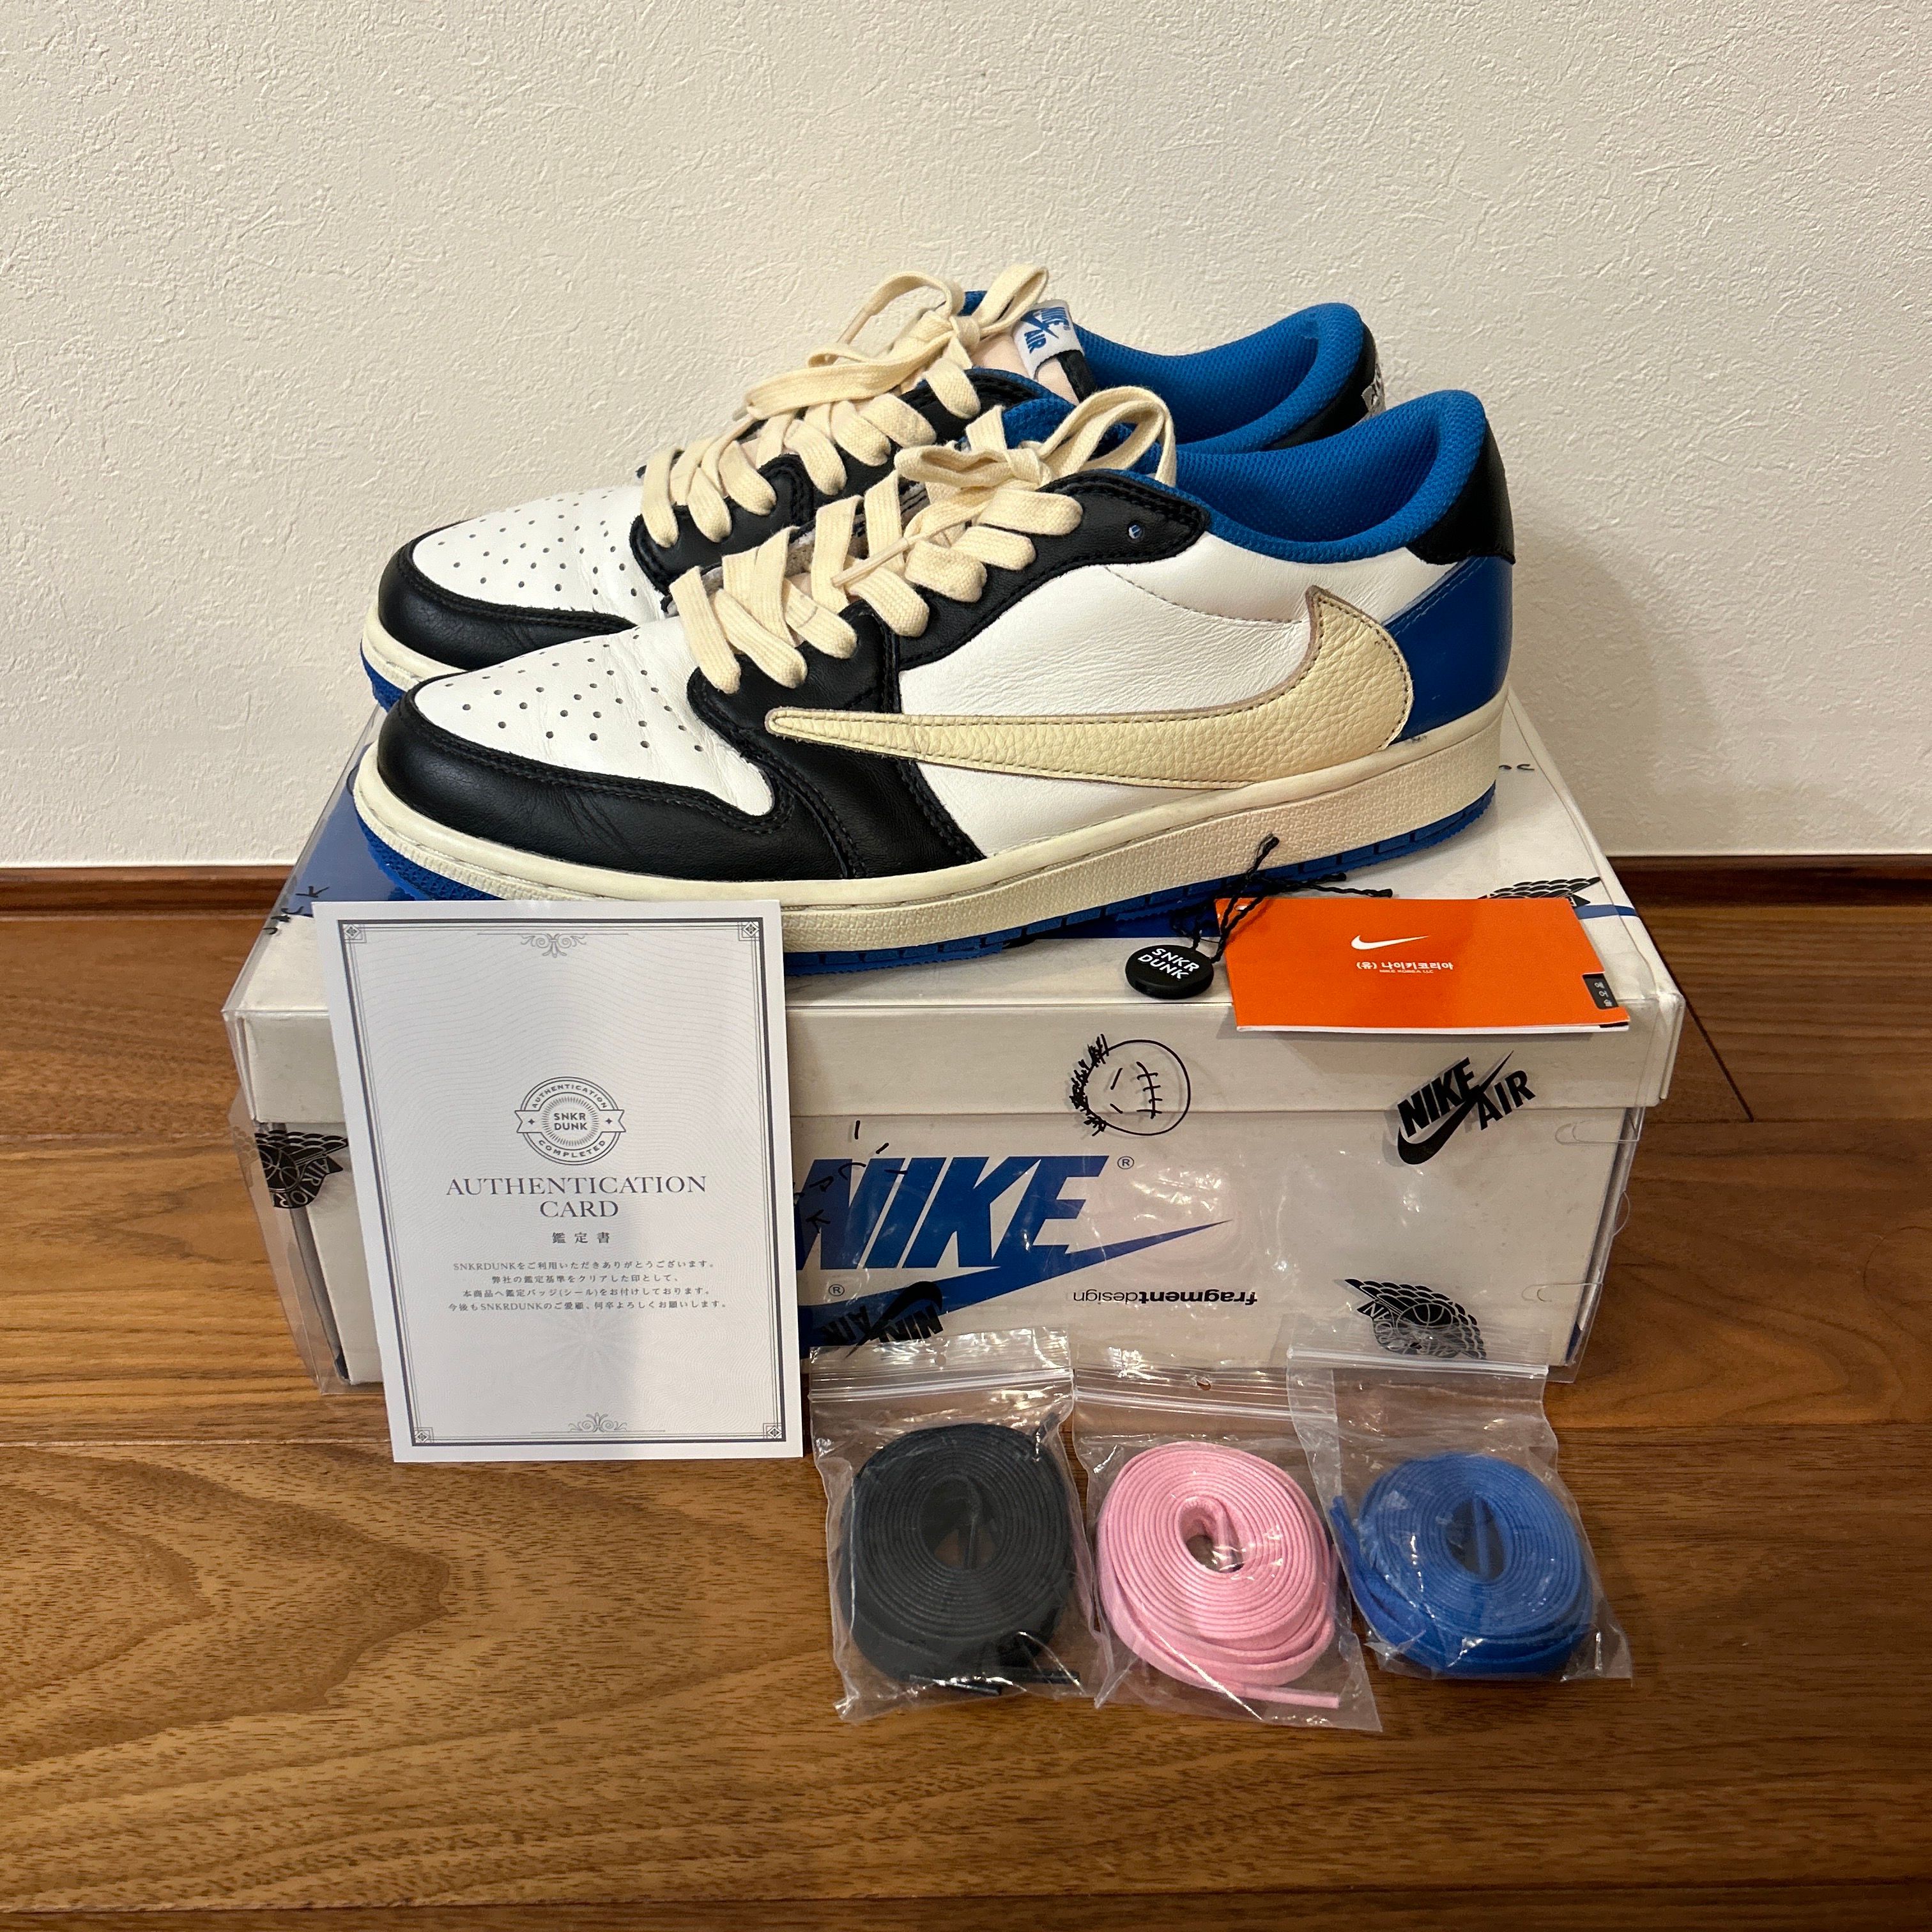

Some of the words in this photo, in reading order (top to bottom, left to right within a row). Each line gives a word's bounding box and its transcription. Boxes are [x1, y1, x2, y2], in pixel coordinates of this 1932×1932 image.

[1023, 329, 1046, 354] AIR
[1137, 954, 1189, 979] DUNK
[1151, 948, 1200, 972] SNKR
[1381, 962, 1453, 970] 나이키코리아
[532, 1084, 608, 1109] AUTHENTICATION
[1397, 1057, 1481, 1138] NIKE
[1477, 1070, 1536, 1131] AIR
[554, 1112, 586, 1121] SNKR
[539, 1140, 606, 1158] COMPLETED
[446, 1176, 707, 1195] AUTHENTICATION
[539, 1200, 619, 1218] CARD
[794, 1155, 1110, 1270] NIKE
[552, 1232, 610, 1244] 鑑定書
[1073, 1289, 1259, 1306] fragmentdesign
